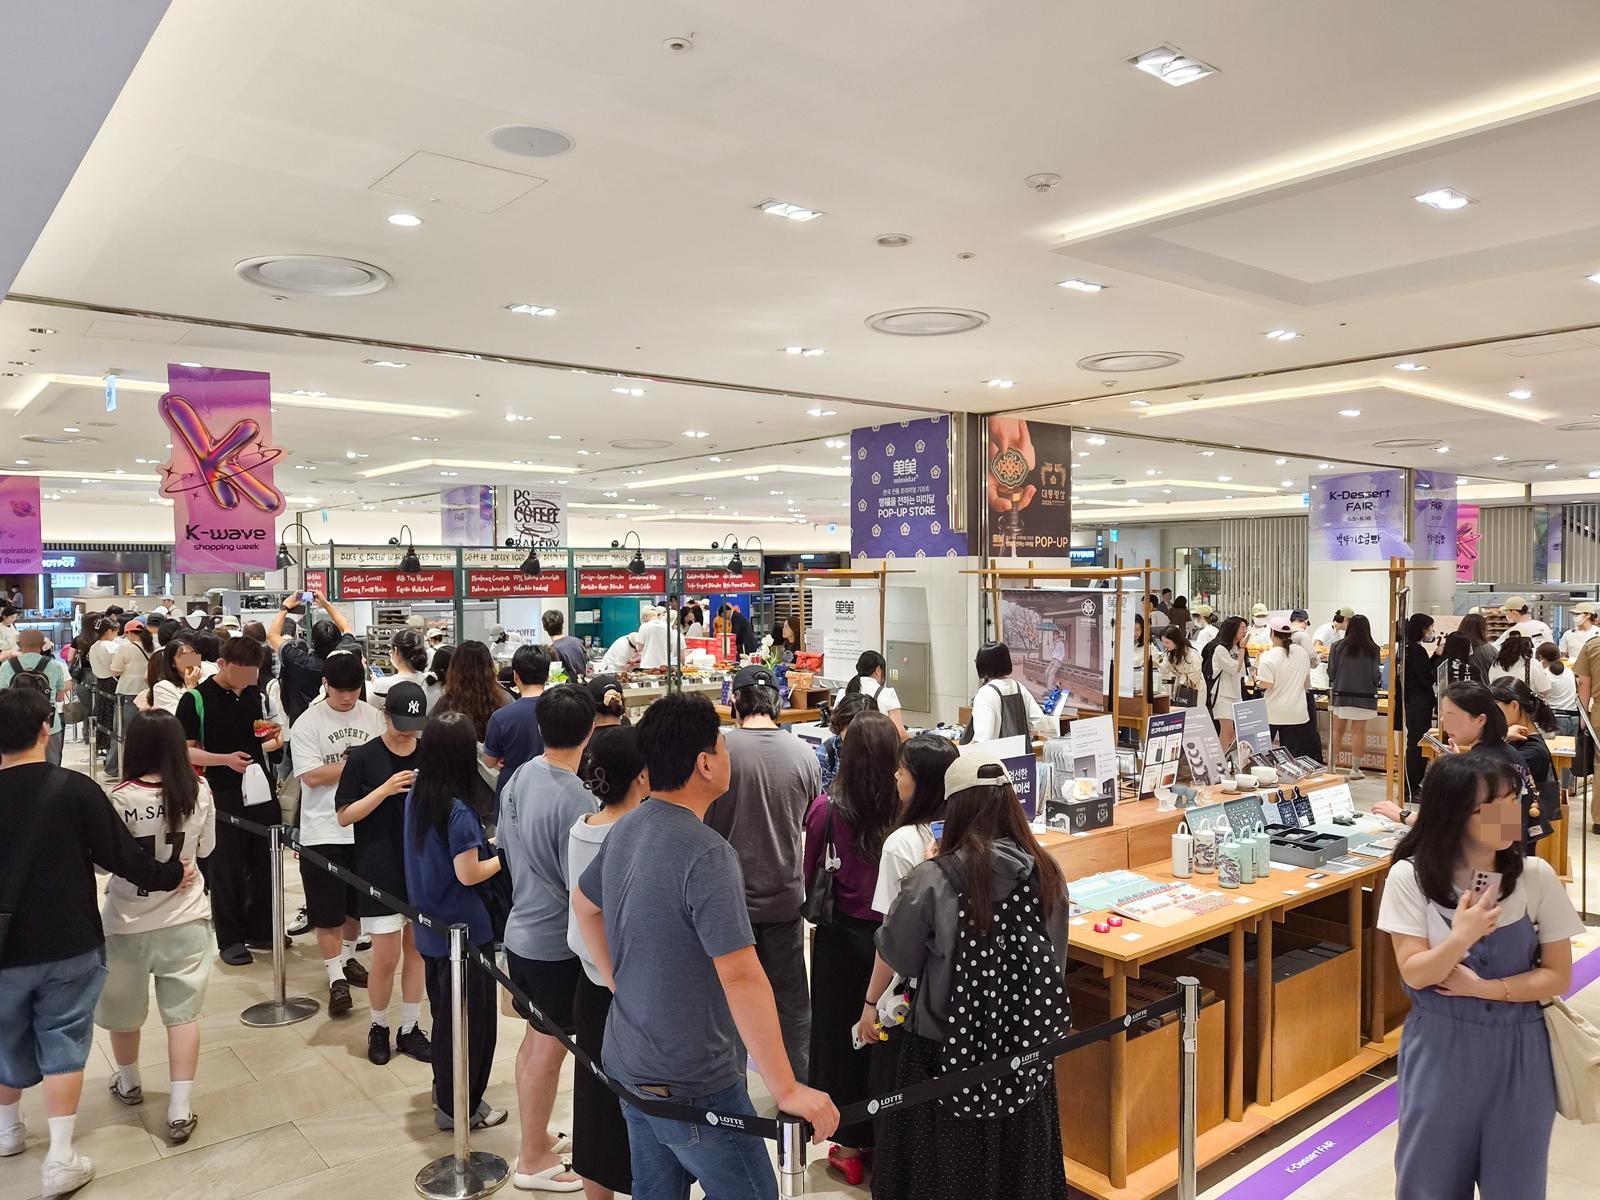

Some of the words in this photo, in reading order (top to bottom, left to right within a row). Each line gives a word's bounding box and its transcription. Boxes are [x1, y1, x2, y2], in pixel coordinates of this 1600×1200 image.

[513, 489, 531, 507] PS
[897, 495, 915, 506] 전하는
[916, 493, 935, 504] 미미달
[1329, 488, 1391, 501] K-Dessert
[878, 507, 907, 518] POP-UP
[909, 505, 936, 517] STORE
[1346, 502, 1374, 512] FAIR
[1430, 501, 1443, 511] FAIR
[513, 505, 561, 524] COFFEE
[185, 525, 266, 541] K-wave
[193, 543, 235, 551] shopping
[236, 543, 260, 551] week
[1034, 536, 1068, 548] POP-UP
[0, 547, 37, 556] spiration
[464, 553, 487, 562] COFFEE
[407, 700, 420, 714] NY
[328, 728, 370, 744] PROPERTY
[1014, 781, 1031, 794] 이션
[1021, 1050, 1040, 1063] LOTTE
[880, 1093, 904, 1106] LOTTE
[719, 1115, 745, 1127] LOTTE
[1316, 1140, 1337, 1155] FAIR
